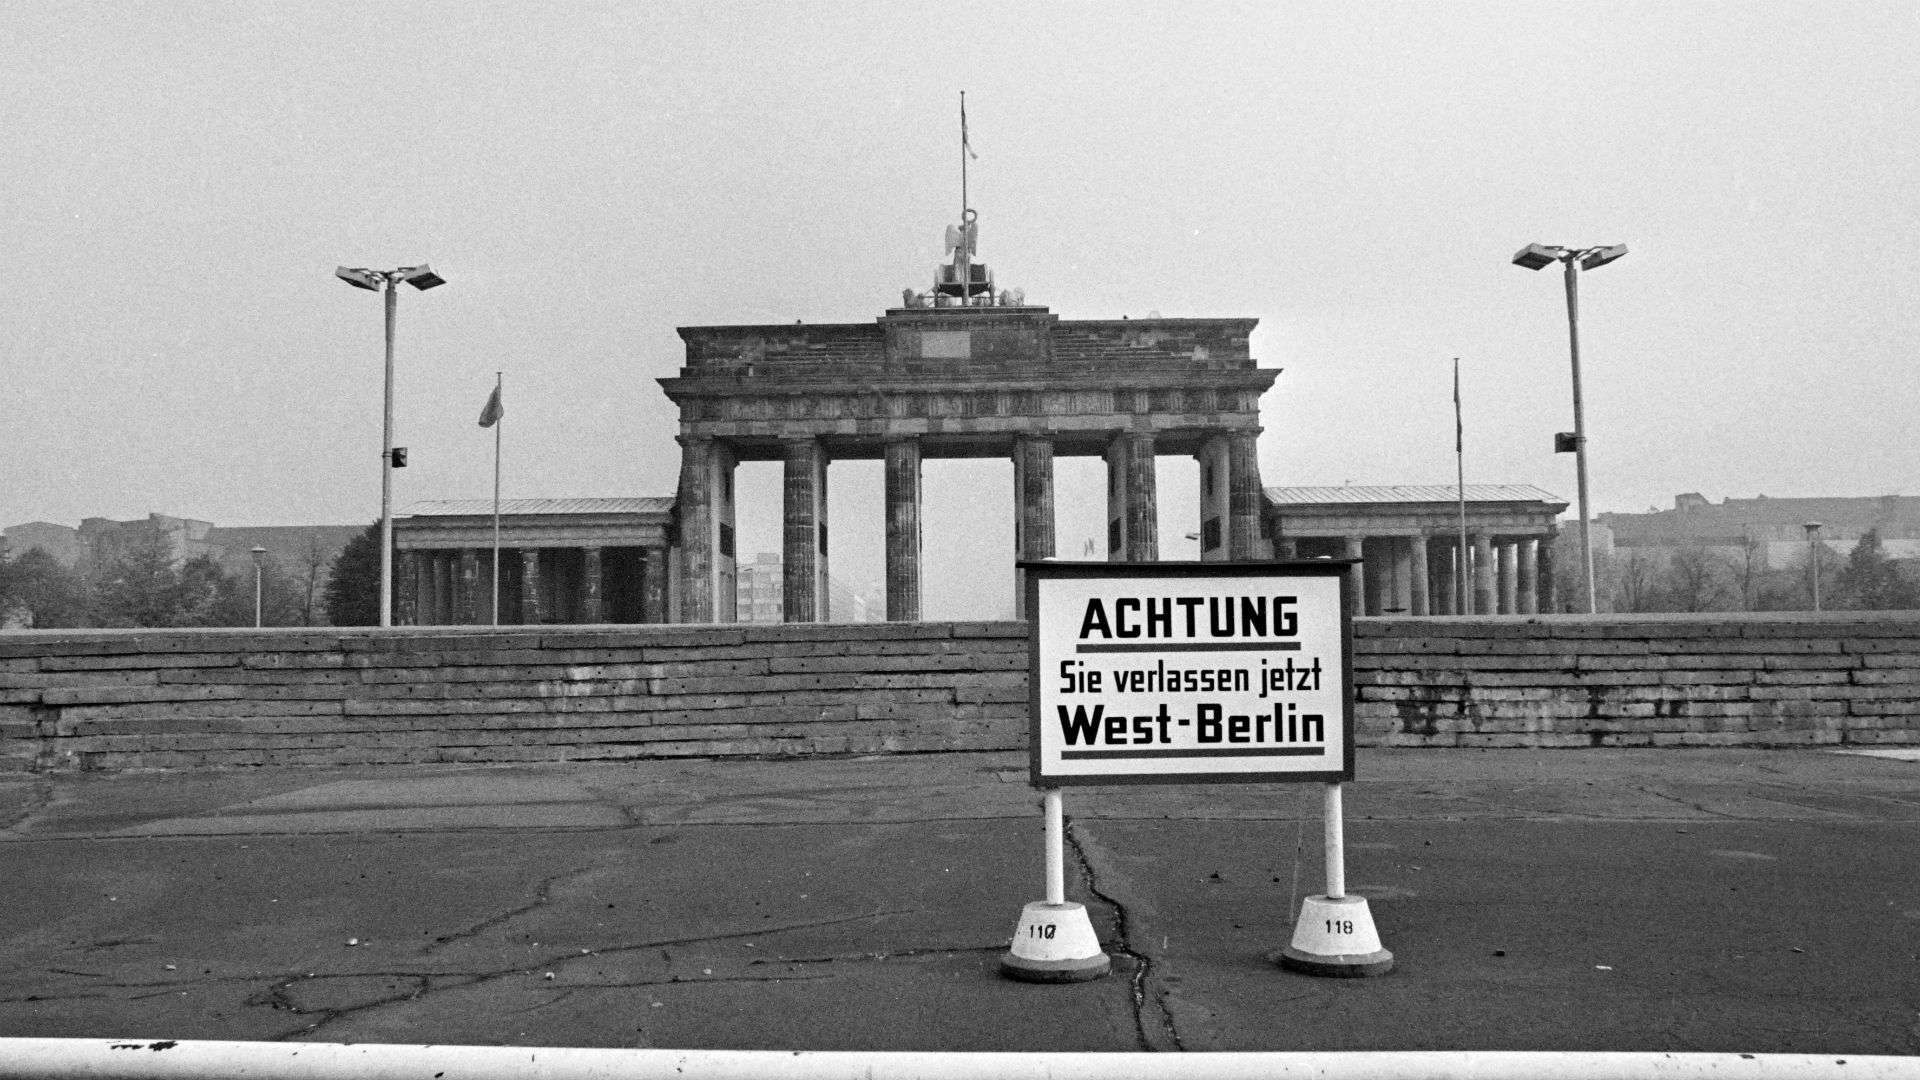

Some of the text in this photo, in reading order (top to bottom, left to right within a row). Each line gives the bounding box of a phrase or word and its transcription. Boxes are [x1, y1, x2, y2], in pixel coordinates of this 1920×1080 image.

[1080, 595, 1298, 639] ACHTUNG
[1060, 657, 1322, 698] Sie verlassen jetzt
[1057, 703, 1325, 746] West-Berlin
[1325, 919, 1354, 935] 118
